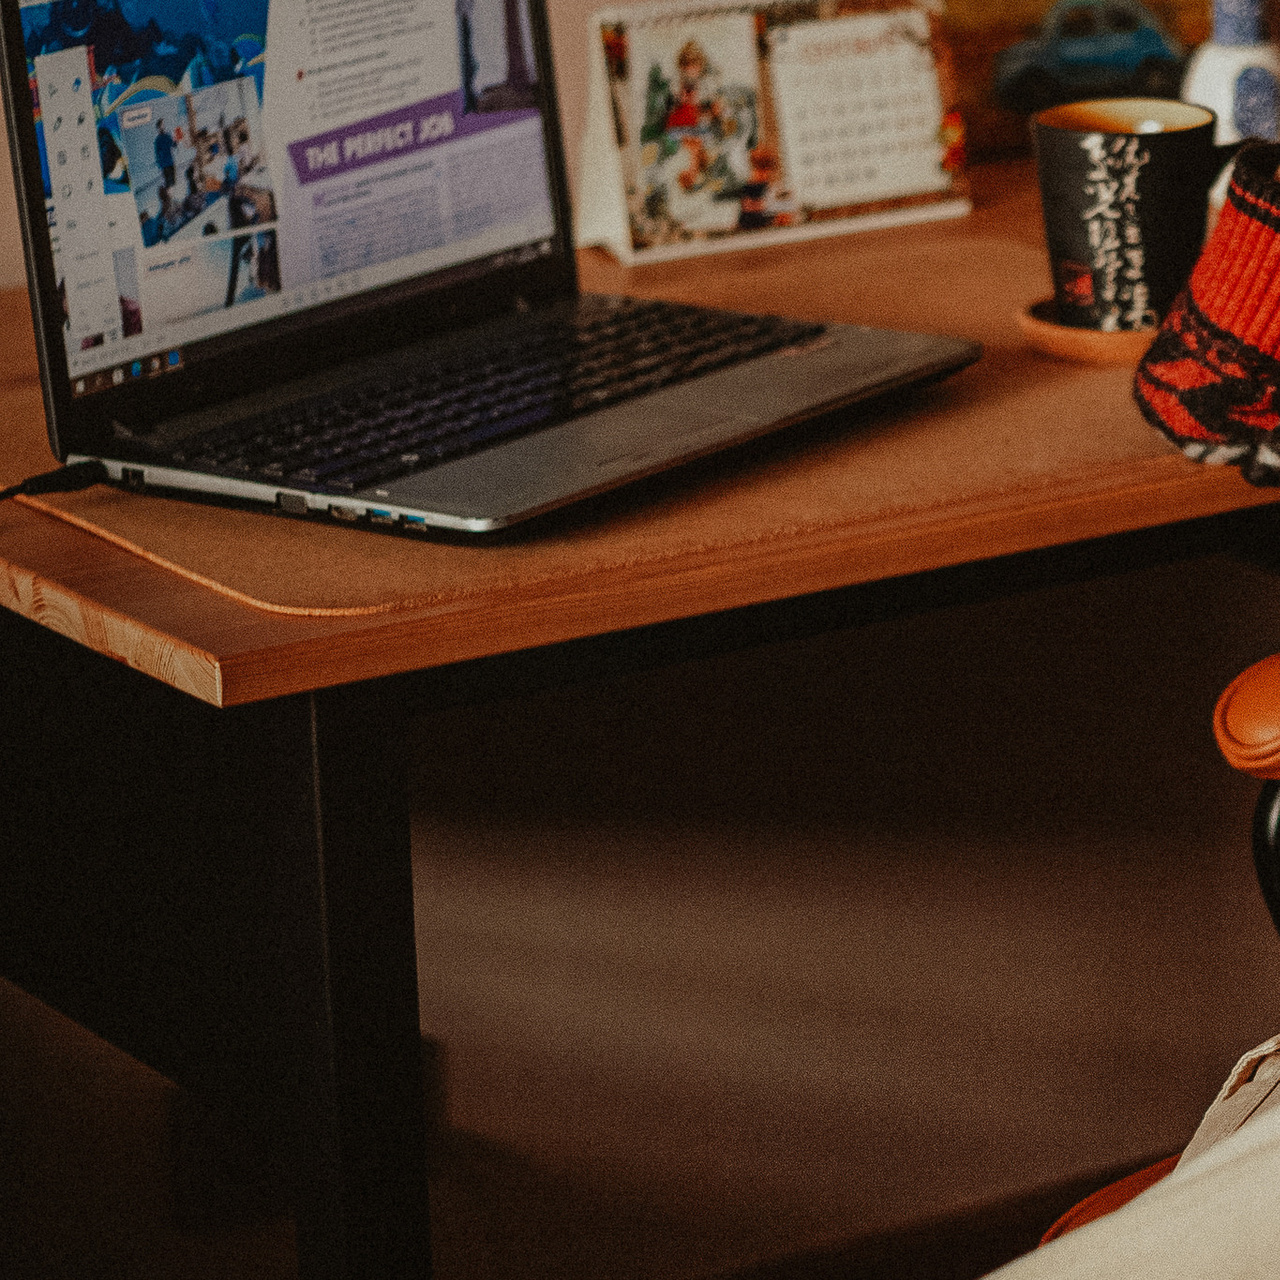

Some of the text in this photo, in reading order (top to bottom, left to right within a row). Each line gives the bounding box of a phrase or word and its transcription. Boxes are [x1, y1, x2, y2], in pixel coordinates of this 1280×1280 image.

[305, 110, 455, 170] THE PERFECT JOB
